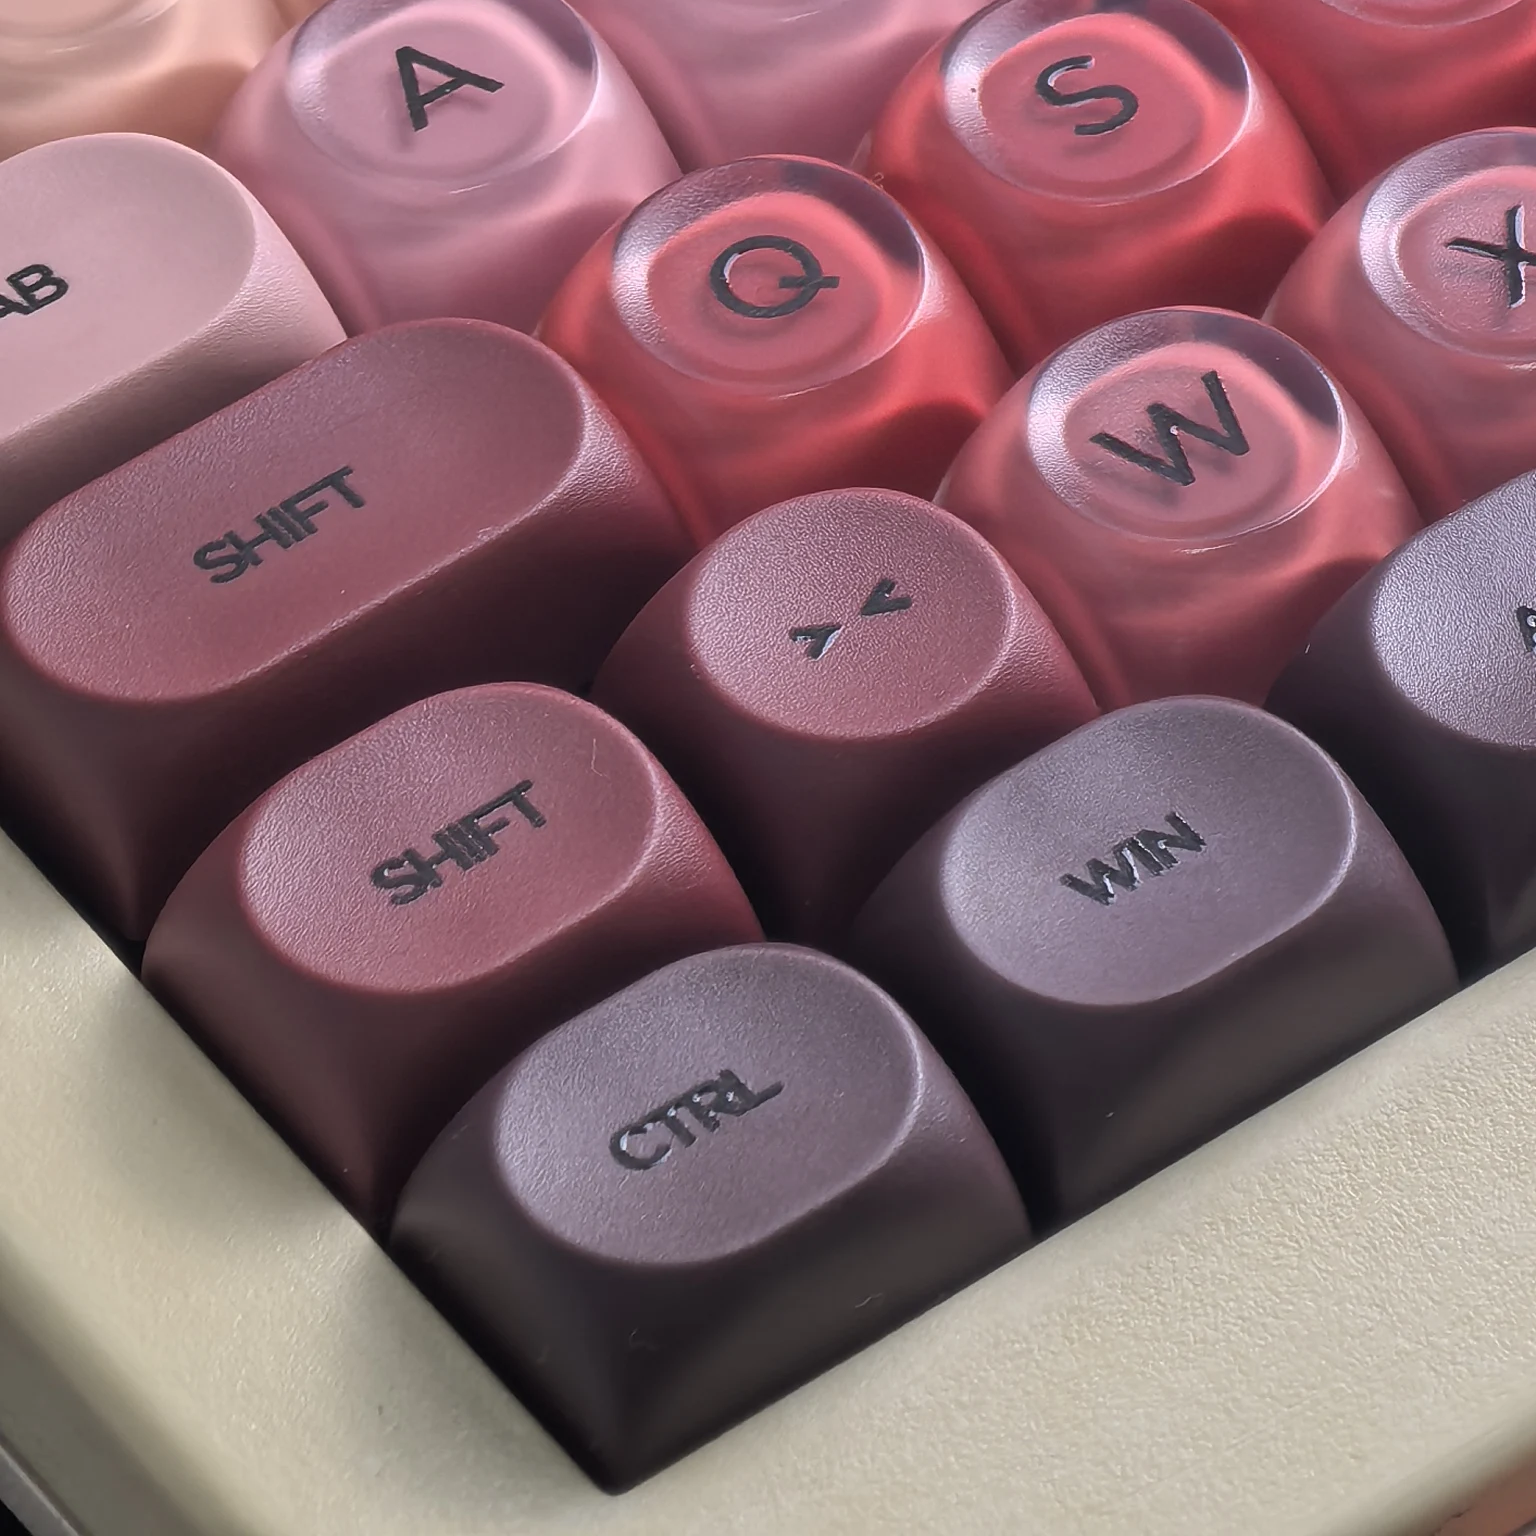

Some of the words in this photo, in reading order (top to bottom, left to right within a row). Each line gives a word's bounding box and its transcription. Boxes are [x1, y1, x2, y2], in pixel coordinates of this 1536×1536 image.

[394, 44, 505, 133] A
[1033, 54, 1140, 136] S
[708, 234, 842, 320] Q
[1088, 369, 1252, 487] W
[191, 464, 368, 586] SHIFT
[368, 778, 550, 908] SHIFT
[1058, 808, 1208, 908] WIN
[606, 1066, 784, 1174] CTRL
